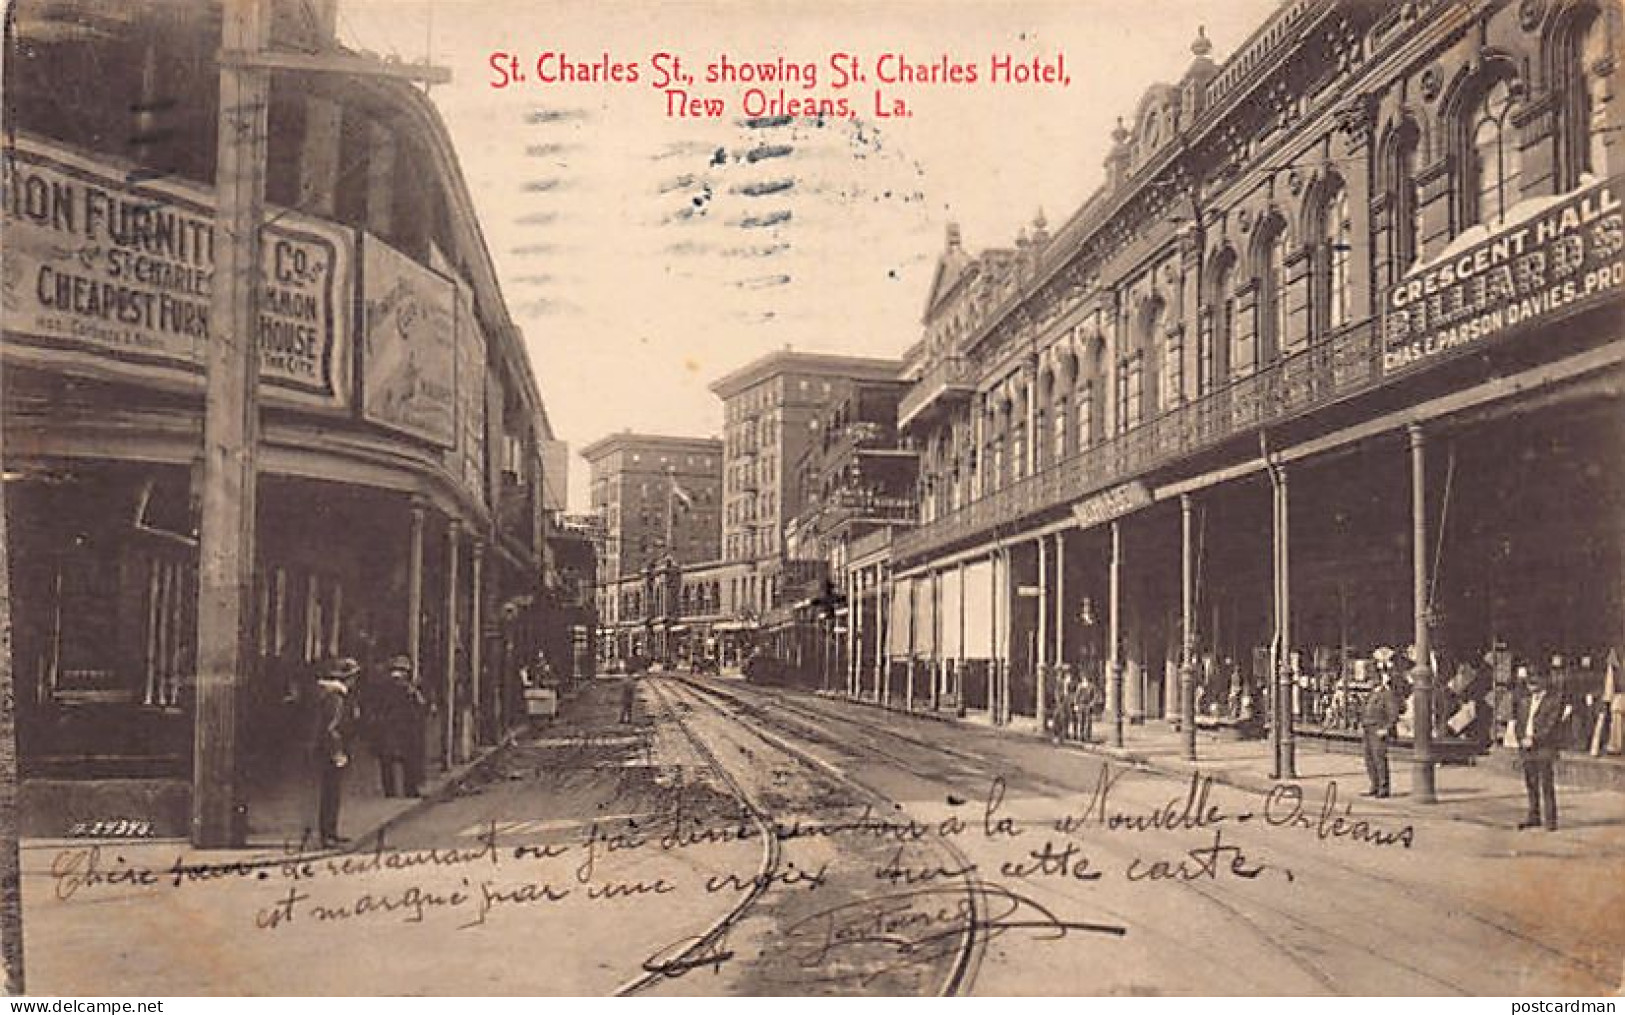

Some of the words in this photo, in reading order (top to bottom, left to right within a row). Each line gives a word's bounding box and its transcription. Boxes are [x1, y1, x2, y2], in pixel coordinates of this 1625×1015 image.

[1383, 214, 1623, 340] BILLIARDS
[1392, 230, 1529, 307] CRESCENT
[1537, 188, 1623, 244] HALL
[37, 264, 153, 331] CHEAPEST
[260, 314, 317, 359] HOUSE
[1438, 312, 1502, 349] PARSON
[327, 817, 501, 877] restaurant
[984, 777, 1025, 838] la
[256, 886, 309, 930] est
[310, 876, 468, 923] marqué
[458, 881, 568, 930] par
[588, 878, 676, 900] une
[705, 861, 828, 894] croix
[874, 845, 978, 886] sur
[1001, 842, 1102, 880] cette
